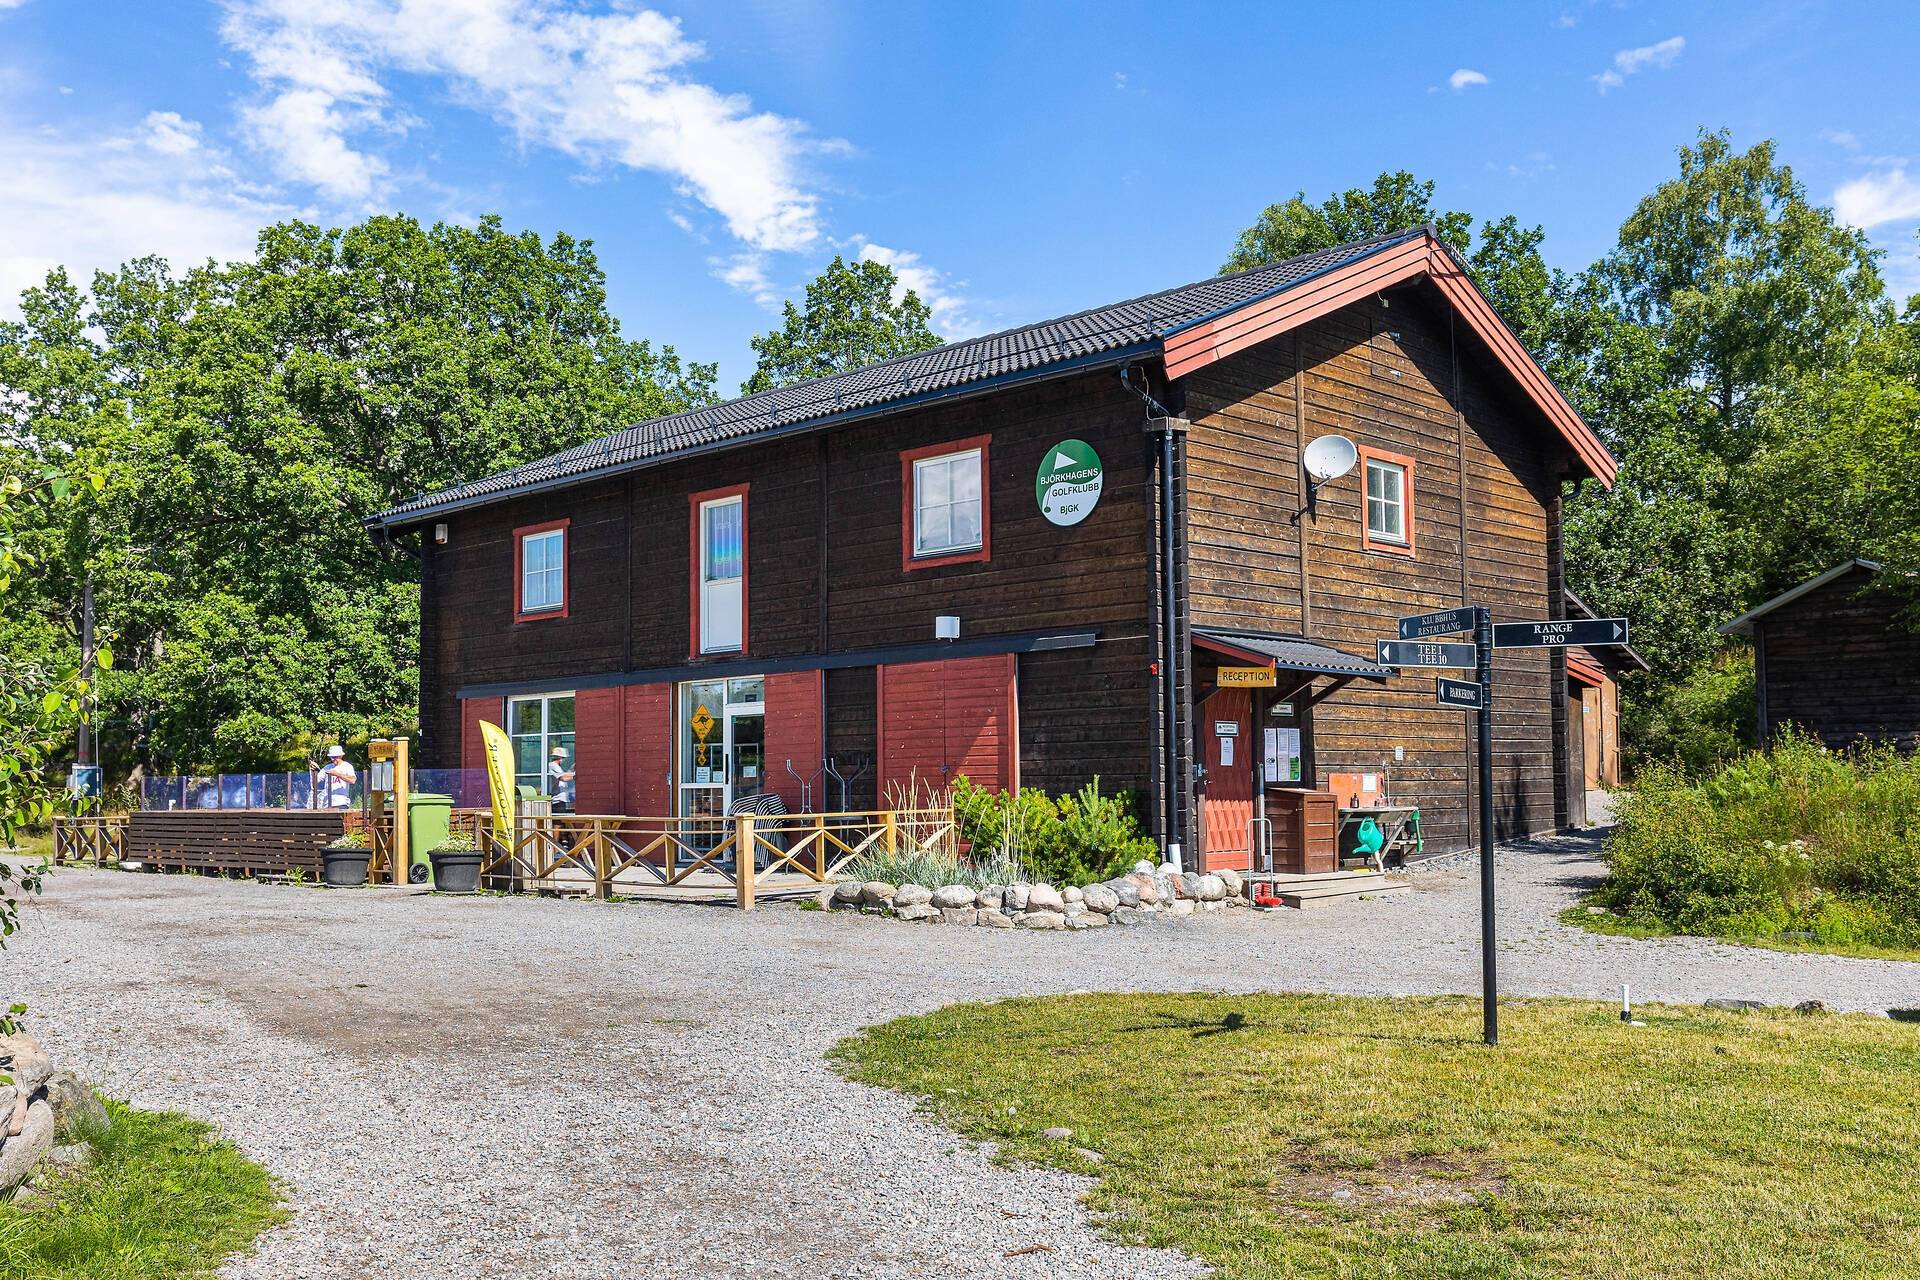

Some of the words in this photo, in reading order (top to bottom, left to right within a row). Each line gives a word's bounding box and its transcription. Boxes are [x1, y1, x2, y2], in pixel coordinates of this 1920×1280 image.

[1040, 468, 1099, 485] BJÖRKHAGENS
[1052, 483, 1099, 497] GOLFKLUBB
[1060, 504, 1079, 515] BjGK
[1421, 612, 1457, 625] KLUBBHUS
[1418, 621, 1461, 636] RESTAURANG
[1534, 624, 1573, 634] RANGE
[1542, 634, 1565, 644] PRO
[1418, 645, 1437, 654] TEE
[1438, 645, 1442, 654] 1
[1418, 654, 1437, 664] TEE
[1438, 655, 1447, 665] 10
[1223, 671, 1270, 681] RECEPTION
[1449, 687, 1476, 700] PARKERING
